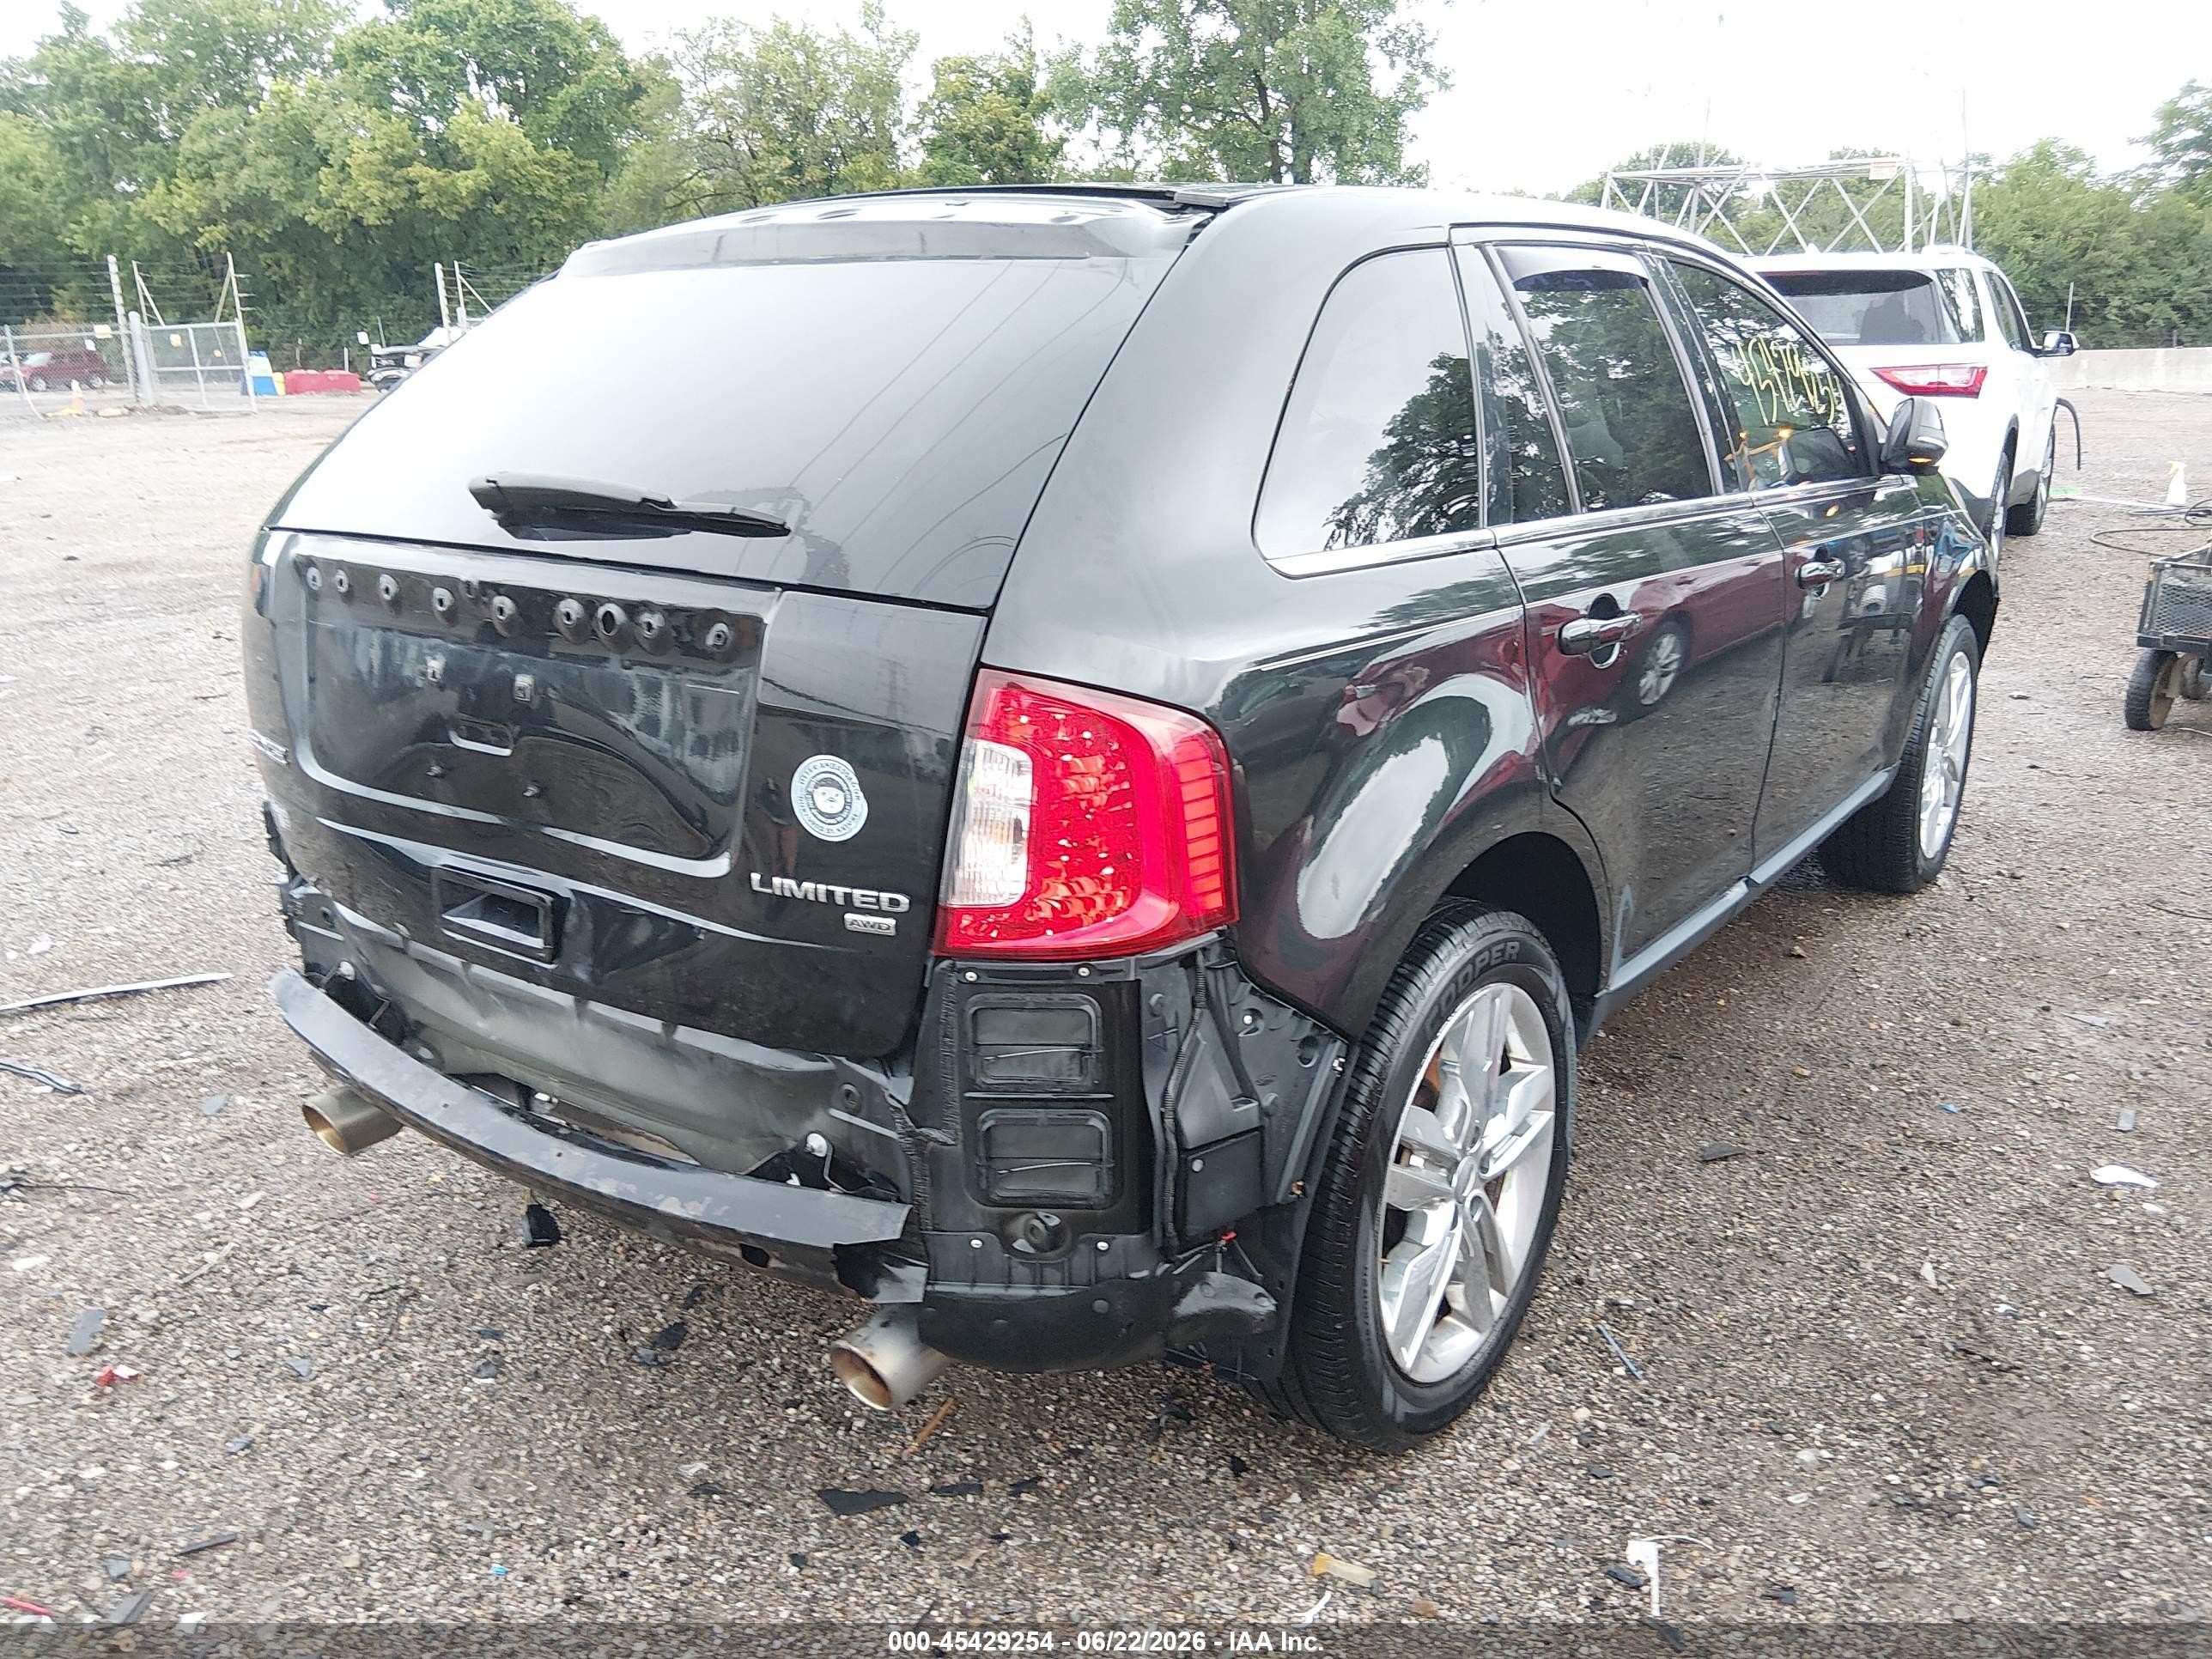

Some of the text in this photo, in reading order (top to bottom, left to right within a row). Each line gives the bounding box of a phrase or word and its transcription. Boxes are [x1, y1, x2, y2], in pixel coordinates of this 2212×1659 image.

[750, 872, 912, 913] LIMITED
[847, 917, 892, 933] AWD
[1424, 941, 1521, 1033] COOPER
